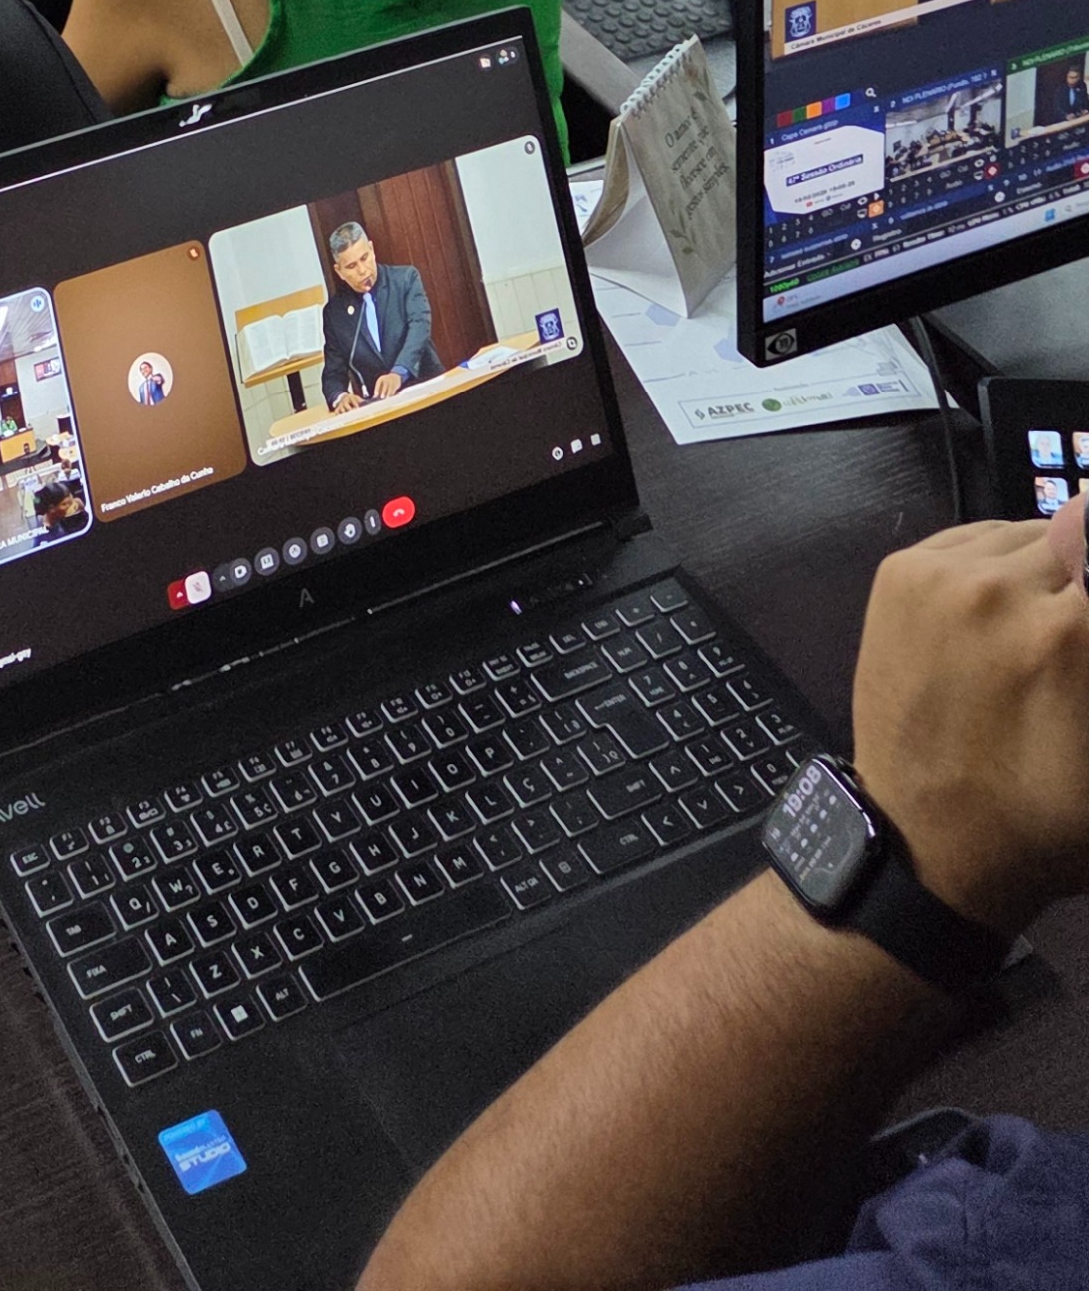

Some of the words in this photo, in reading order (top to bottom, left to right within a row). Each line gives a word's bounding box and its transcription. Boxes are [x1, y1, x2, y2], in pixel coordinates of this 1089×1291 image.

[665, 132, 674, 148] O
[708, 402, 755, 416] AZPEC
[101, 498, 126, 513] Franco
[190, 467, 214, 480] Cunha
[782, 765, 822, 818] 19:08
[168, 879, 184, 894] W
[211, 862, 224, 875] E
[252, 845, 265, 858] R
[290, 827, 303, 840] T
[330, 811, 342, 823] Y
[369, 795, 382, 807] U
[484, 747, 495, 759] P
[164, 932, 177, 946] A
[206, 914, 219, 928] S
[246, 896, 259, 909] D
[288, 878, 299, 891] F
[328, 861, 341, 874] G
[367, 844, 381, 857] H
[411, 827, 420, 840] J
[445, 809, 459, 823] K
[484, 795, 497, 807] L
[209, 964, 223, 979] Z
[250, 945, 265, 960] X
[292, 927, 305, 940] C
[333, 909, 346, 922] V
[373, 892, 388, 905] B
[413, 873, 427, 887] N
[452, 856, 467, 870] M
[134, 1050, 156, 1065] CTRL
[275, 986, 290, 1001] ALT
[179, 1141, 231, 1172] STUDIO
